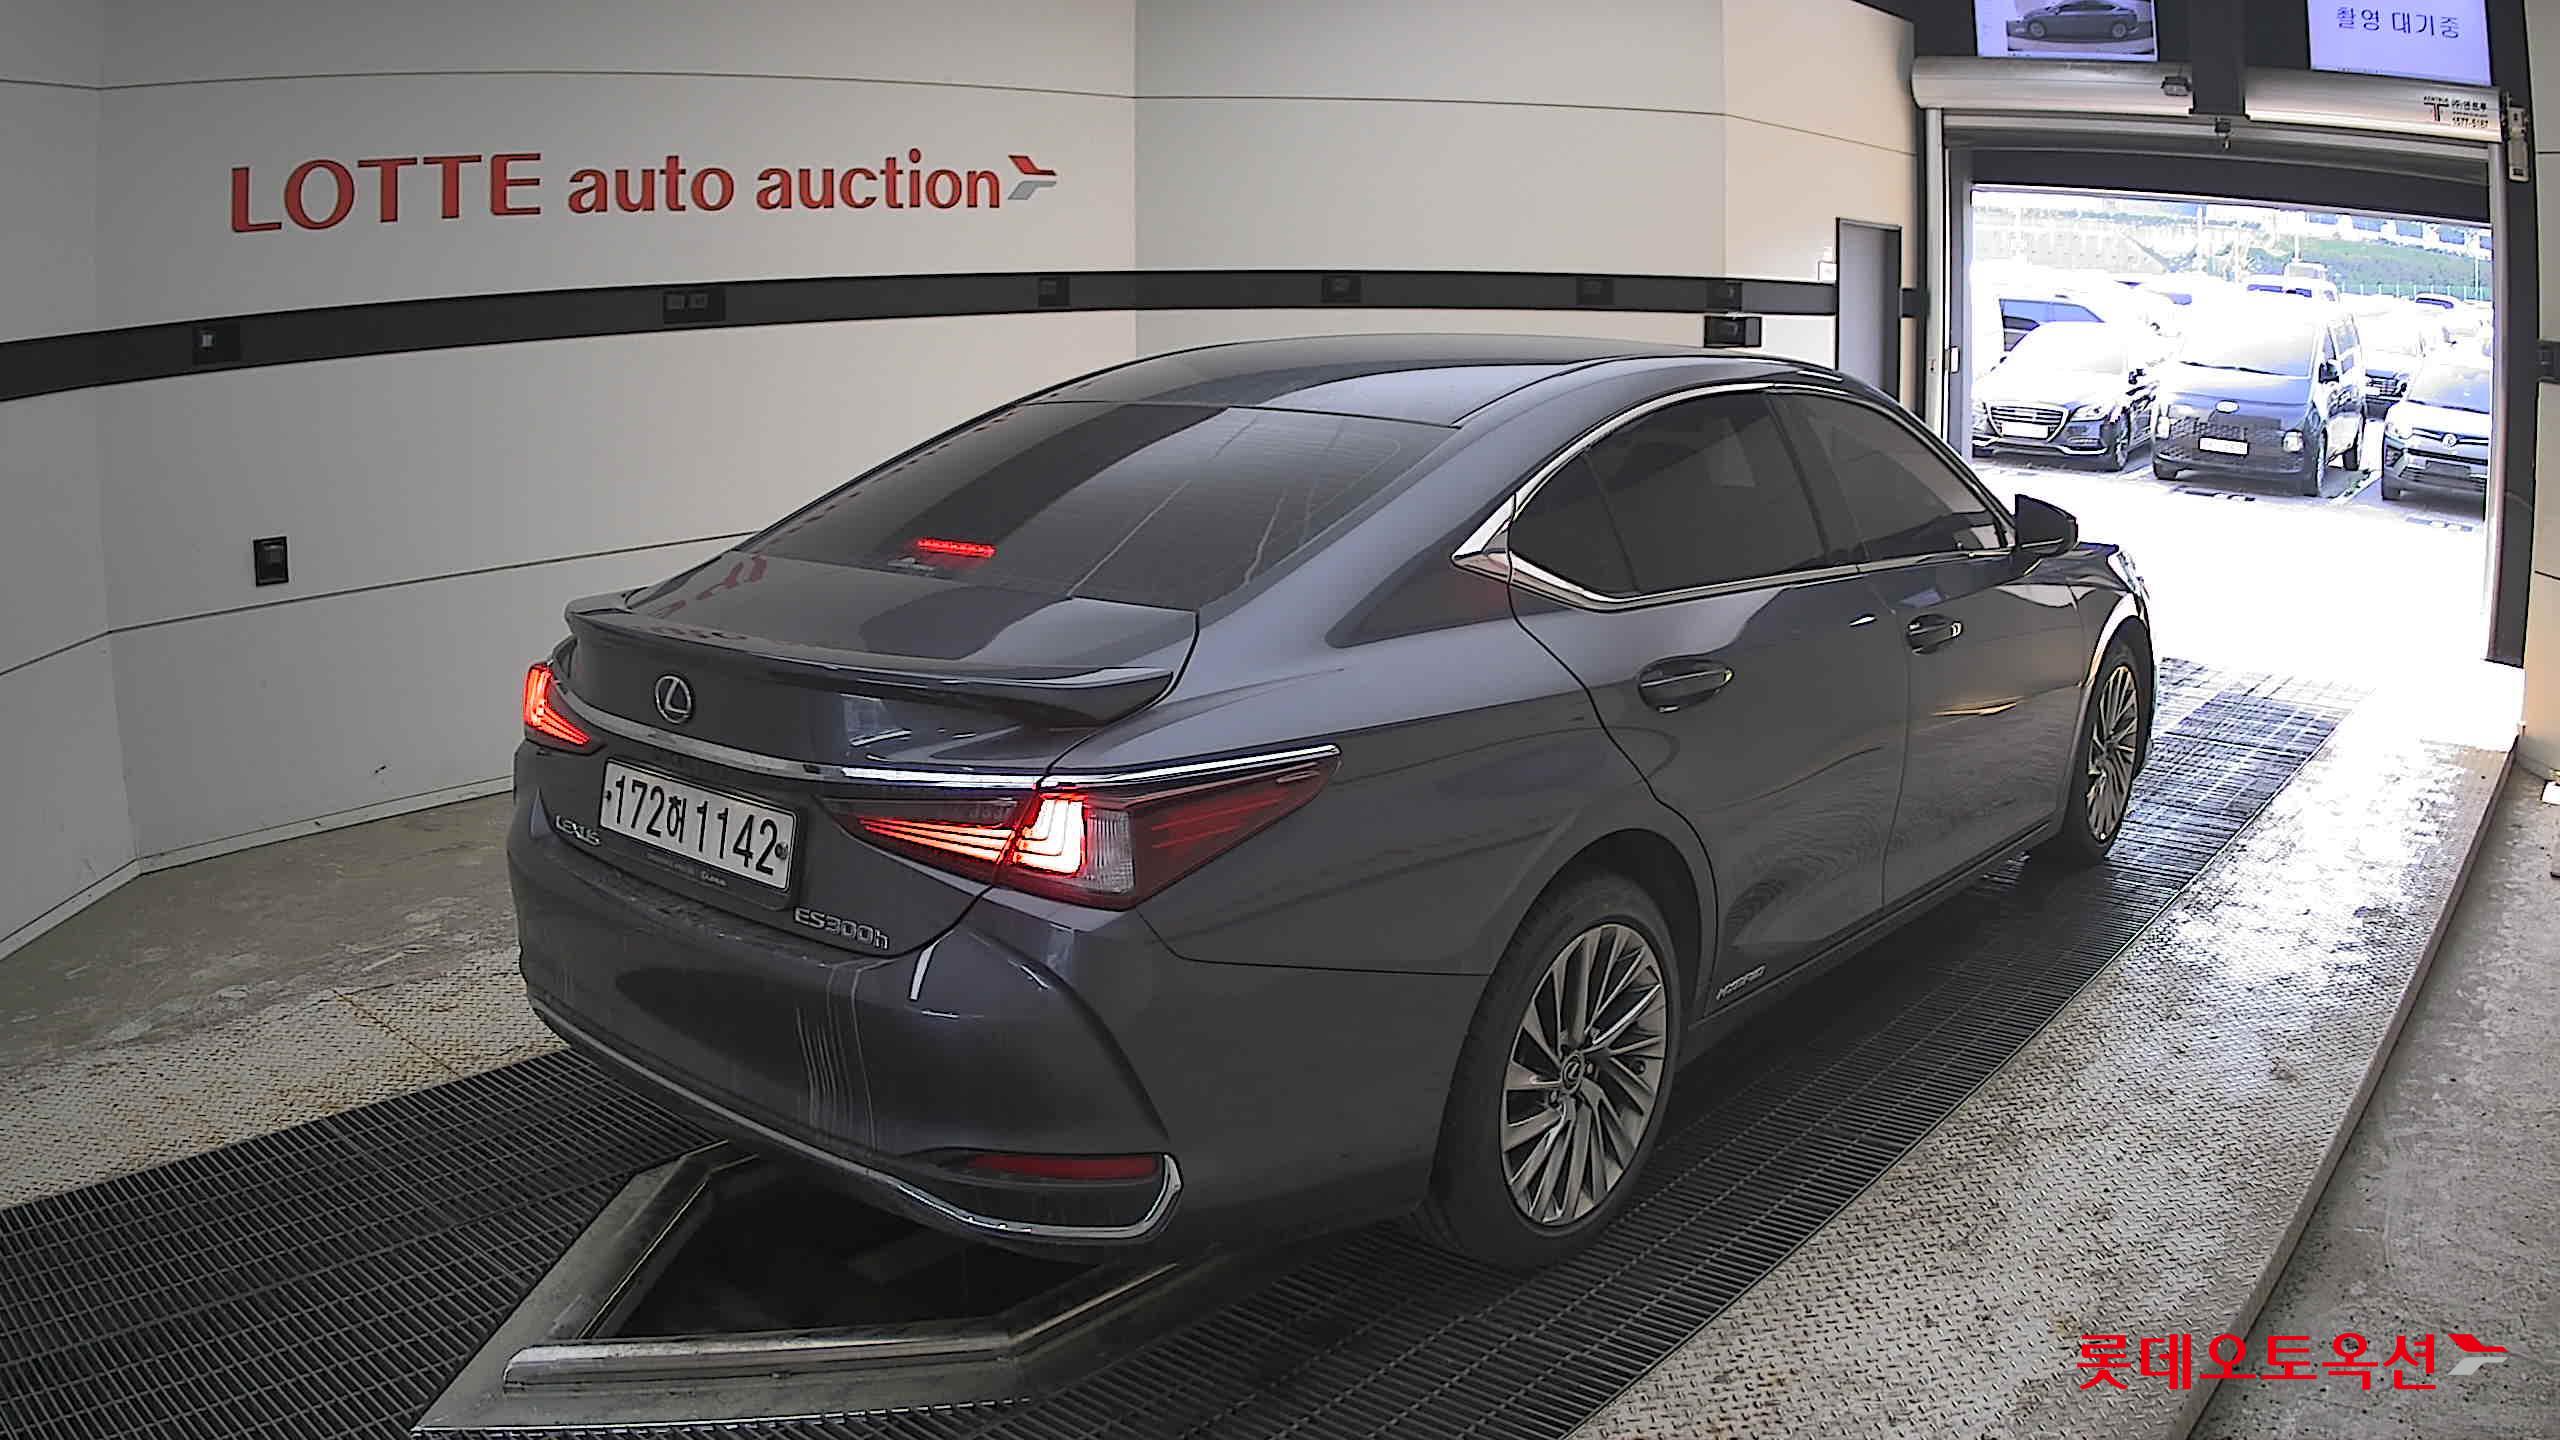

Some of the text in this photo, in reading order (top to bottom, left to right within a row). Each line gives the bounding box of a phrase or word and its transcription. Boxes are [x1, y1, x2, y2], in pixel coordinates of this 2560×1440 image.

[2337, 6, 2460, 39] 촬영 대기중
[230, 147, 1003, 233] LOTTE auto auction
[555, 815, 601, 847] LEXUS
[794, 906, 890, 951] ES300h
